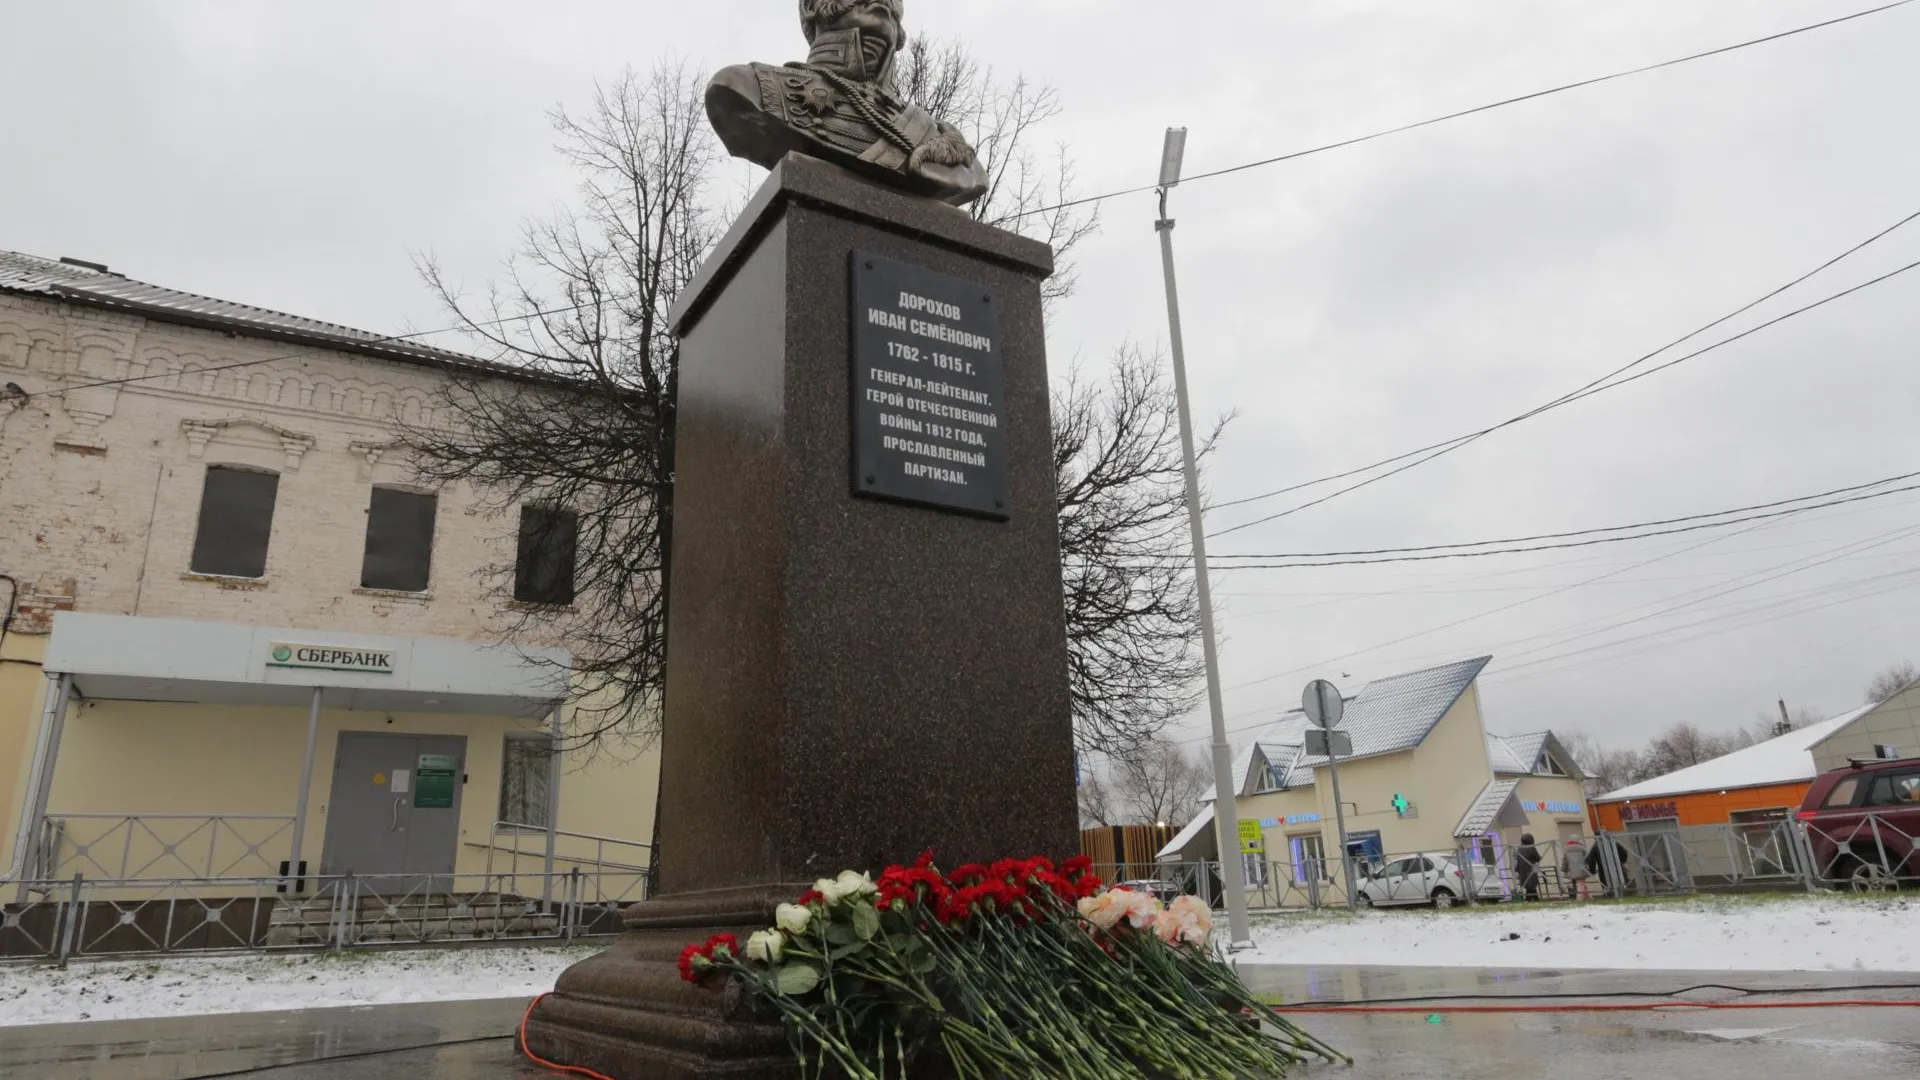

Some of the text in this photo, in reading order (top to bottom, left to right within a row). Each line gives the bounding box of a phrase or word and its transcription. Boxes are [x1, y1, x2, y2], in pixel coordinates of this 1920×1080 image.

[898, 291, 961, 321] ДОРОХОВ
[868, 307, 991, 353] ИВАН СЕМЁНОВИЧ
[887, 341, 920, 362] 1762
[932, 352, 963, 373] 1815
[870, 367, 993, 407] ГЕНЕРАЛ-ЛЕЙТЕНАНТ.
[866, 388, 998, 429] ГЕРОЙ ОТЕЧЕСТВЕННОЙ
[879, 412, 988, 449] ВОЙНЫ 1812 ГОДА,
[883, 435, 986, 468] ПРОСЛАВЛЕННЫЙ
[904, 461, 969, 486] ПАРТИЗАН.
[296, 647, 391, 668] СБЕРБАНК
